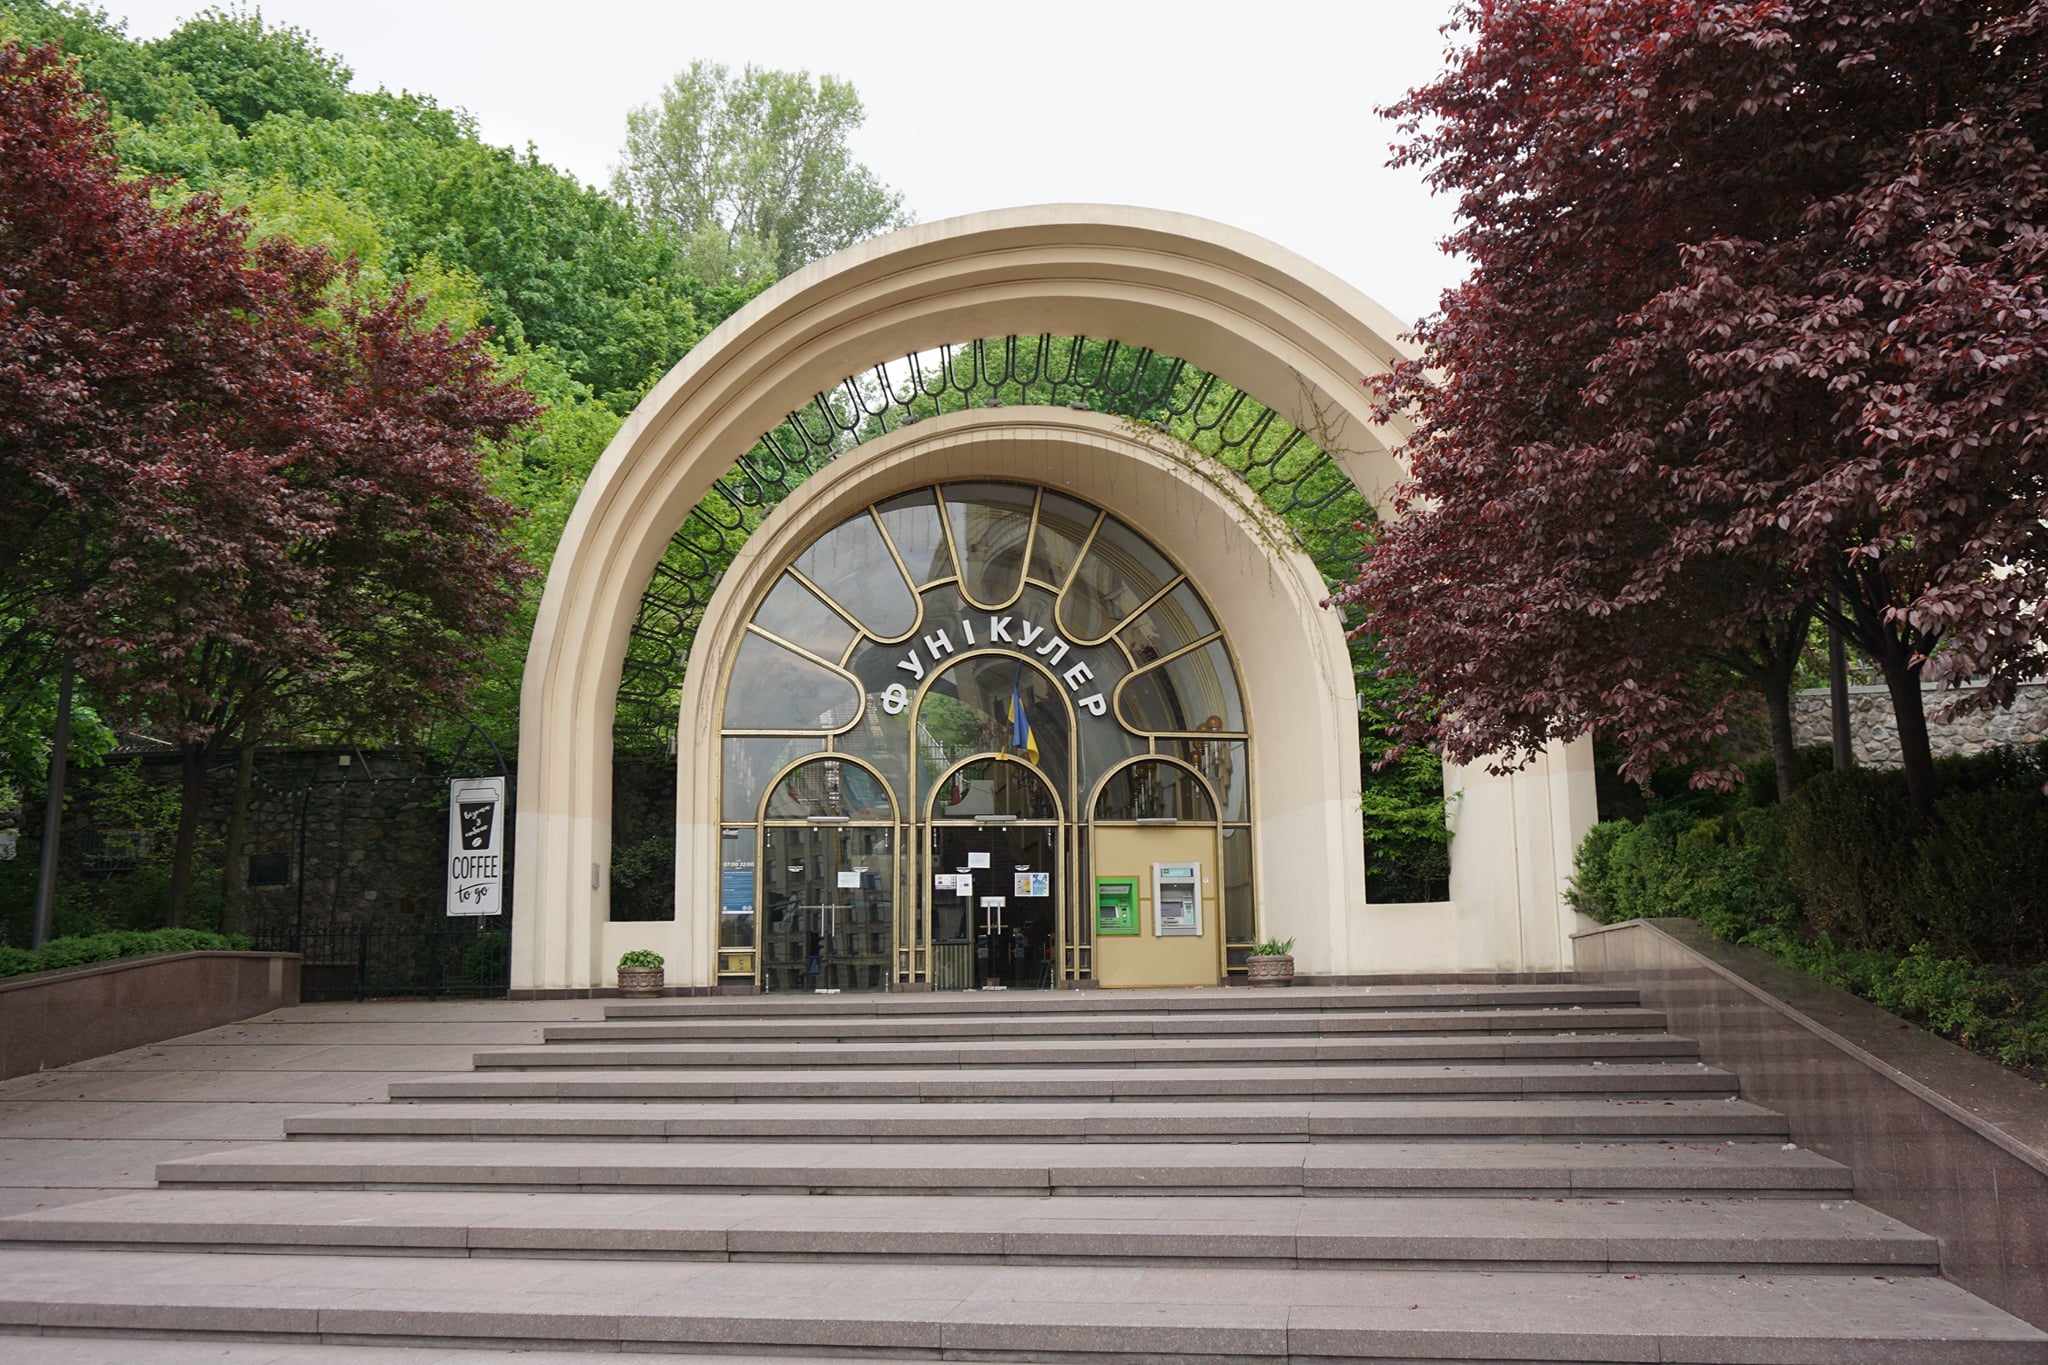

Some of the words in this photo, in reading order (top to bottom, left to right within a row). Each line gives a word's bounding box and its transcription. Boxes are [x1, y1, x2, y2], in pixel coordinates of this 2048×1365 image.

[880, 616, 1107, 717] ФУНІКУЛЕР
[452, 855, 499, 880] COFFEE
[455, 884, 472, 903] to
[474, 887, 490, 905] go
